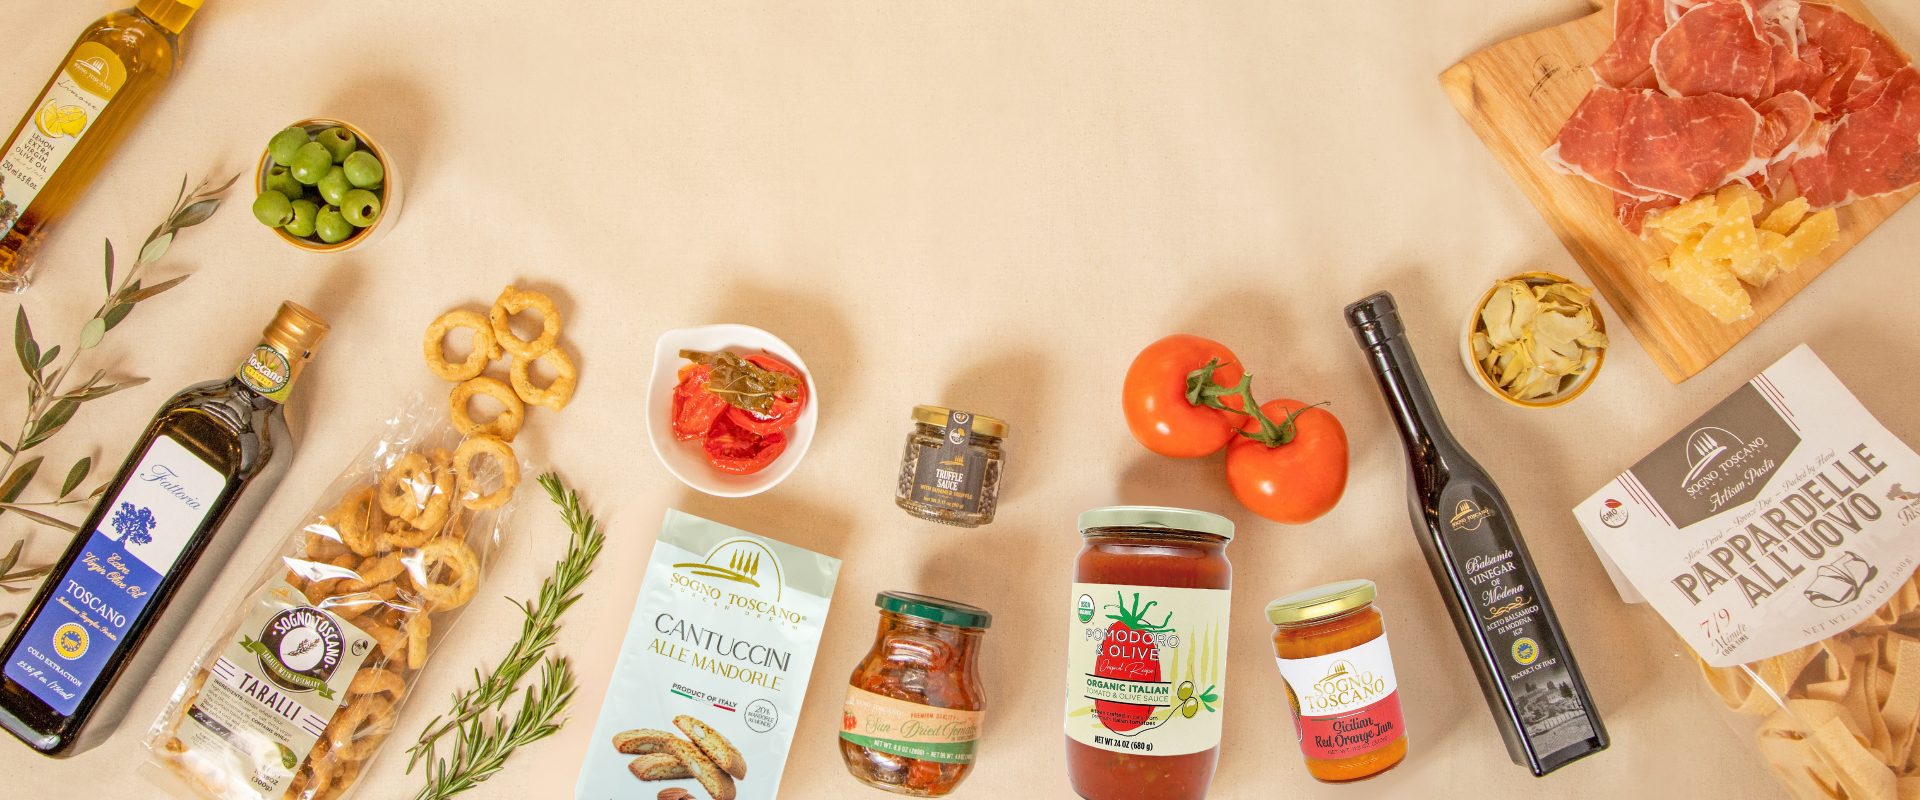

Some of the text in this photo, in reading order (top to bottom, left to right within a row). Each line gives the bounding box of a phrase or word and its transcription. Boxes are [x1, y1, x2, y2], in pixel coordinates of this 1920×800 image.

[24, 144, 47, 163] VIRGIN
[28, 139, 49, 157] EXTRA
[32, 133, 55, 151] LEMON
[2, 160, 14, 171] 250
[16, 146, 34, 163] OLIVE
[35, 162, 48, 173] OIL
[248, 352, 284, 384] Toscano
[936, 468, 964, 484] TRUFFLE
[1686, 437, 1765, 496] SOGNO TOSCANO
[140, 464, 201, 511] Fattoria
[937, 478, 958, 491] SAUCE
[1709, 480, 1745, 513] Artisan
[1744, 458, 1775, 486] Pasta
[1602, 508, 1618, 522] GMO
[1671, 442, 1888, 607] PAPPARDELLE
[1465, 549, 1514, 576] Balsamic
[1734, 491, 1883, 609] ALL'UOVO
[82, 551, 148, 599] Virgin Olive Oil
[107, 552, 130, 575] Extra
[1470, 561, 1516, 587] VINEGAR
[670, 572, 721, 600] SOGNO
[1481, 583, 1525, 607] Modena
[1490, 578, 1501, 587] OF
[66, 579, 126, 628] TOSCANO
[1080, 600, 1091, 609] USDA
[1802, 623, 1825, 637] NET
[1876, 580, 1889, 594] OZ
[1486, 605, 1539, 632] ACETO BALSAMICO
[1497, 616, 1532, 635] DI MODENA
[1700, 608, 1730, 638] 7/9
[274, 611, 312, 635] SOGNO
[313, 614, 340, 665] TOSCANO
[655, 613, 792, 672] CANTUCCINI
[1085, 628, 1180, 649] POMODORO
[1512, 628, 1523, 637] IGP
[1712, 624, 1747, 655] Minute
[1722, 634, 1749, 656] COOK TIME
[647, 638, 785, 692] ALLE MANDORLE
[1096, 644, 1161, 661] & OLIVE
[27, 646, 83, 688] COLD EXTRACTION
[1510, 667, 1535, 681] PRODUCT
[1542, 658, 1557, 668] ITALY
[213, 679, 244, 701] INGREDIENTS:
[672, 683, 739, 709] PRODUCT OF ITALY
[1086, 687, 1111, 698] TOMATO
[1120, 693, 1141, 701] OLIVE
[1143, 695, 1169, 703] SAUCE
[1087, 679, 1169, 694] ORGANIC ITALIAN
[1304, 678, 1385, 710] TOSCANO
[1313, 670, 1374, 697] SOGNO
[239, 673, 302, 721] TARALLI
[251, 717, 274, 735] CONTAINS
[273, 730, 290, 743] WHEAT
[748, 711, 774, 723] MANDORLE
[1333, 717, 1374, 734] Sicilian
[883, 741, 893, 749] WT.
[1094, 735, 1104, 744] NET
[1104, 737, 1113, 746] WT
[1114, 739, 1121, 748] 24
[1122, 740, 1130, 749] OZ
[1315, 736, 1335, 749] Red
[1335, 729, 1375, 747] Orange
[1373, 721, 1393, 737] Jam
[251, 775, 273, 792] (300g)
